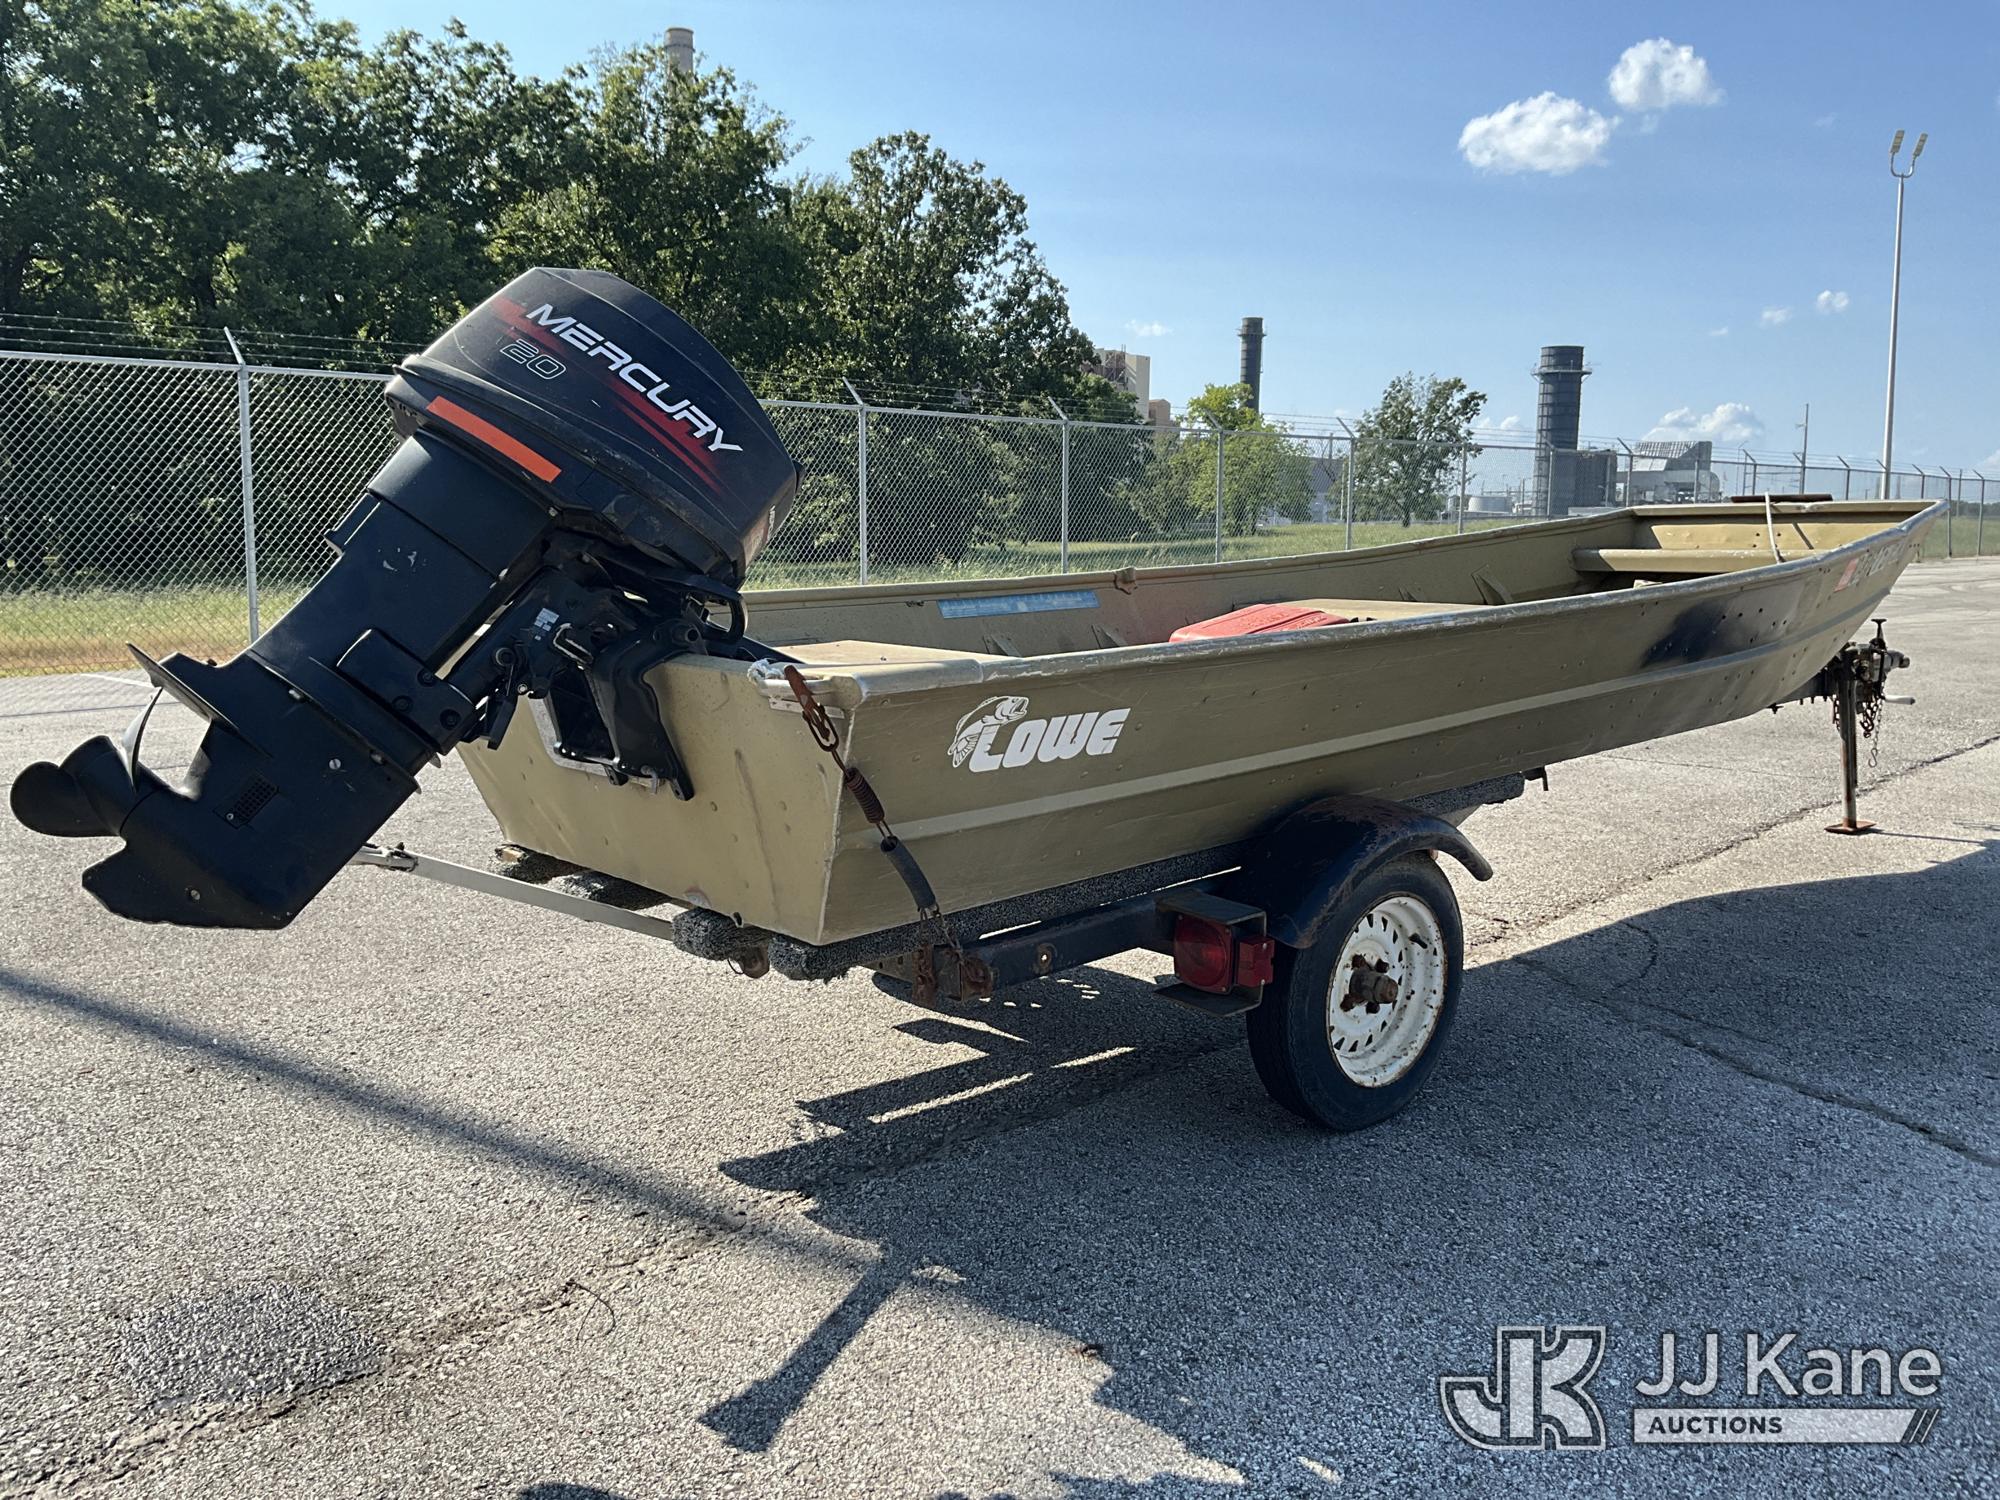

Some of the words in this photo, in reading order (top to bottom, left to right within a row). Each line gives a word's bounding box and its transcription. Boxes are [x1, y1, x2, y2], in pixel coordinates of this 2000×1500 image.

[499, 338, 567, 380] 20
[526, 303, 743, 452] MERCURY
[968, 707, 1131, 773] LOWE
